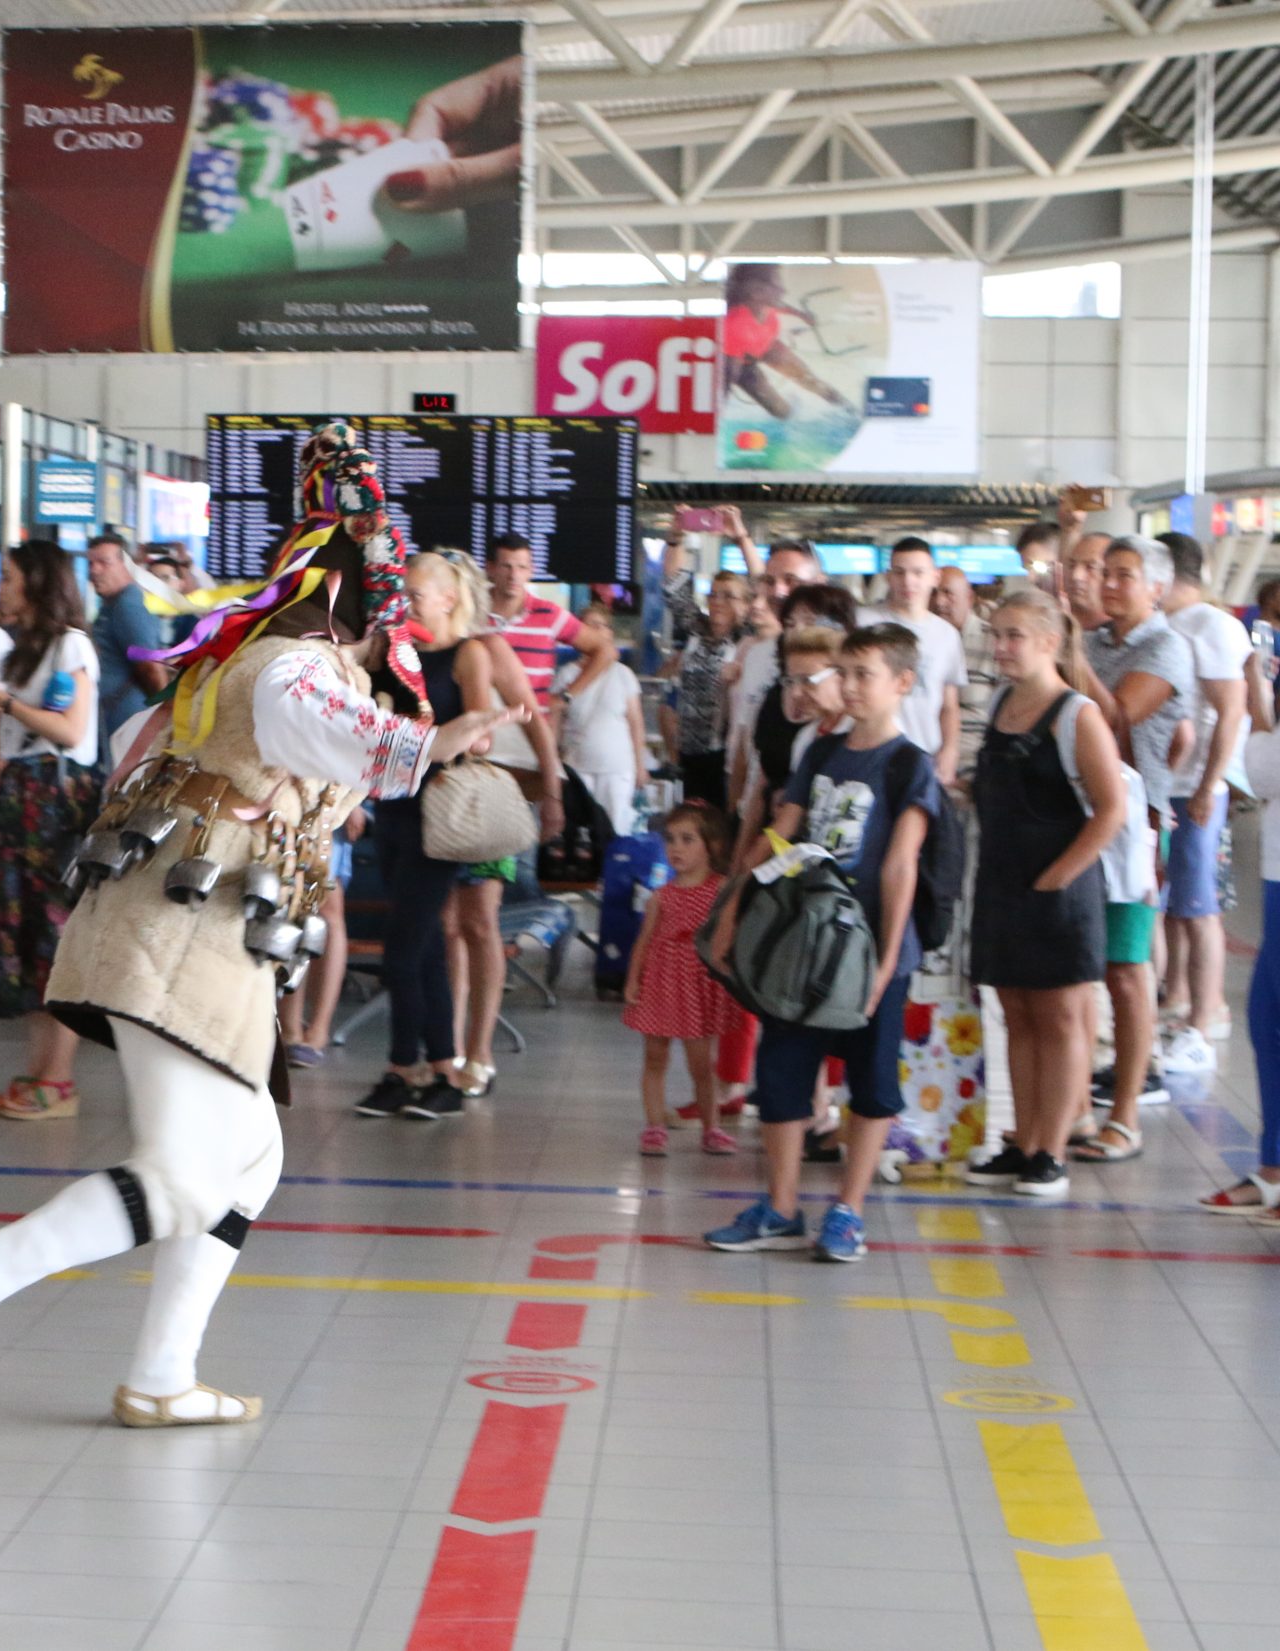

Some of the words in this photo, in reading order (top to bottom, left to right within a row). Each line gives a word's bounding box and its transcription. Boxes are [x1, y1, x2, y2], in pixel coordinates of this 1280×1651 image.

[24, 103, 104, 127] ROYALE
[105, 102, 175, 125] PALMS
[53, 128, 143, 152] CASINO
[552, 336, 716, 414] Sofi
